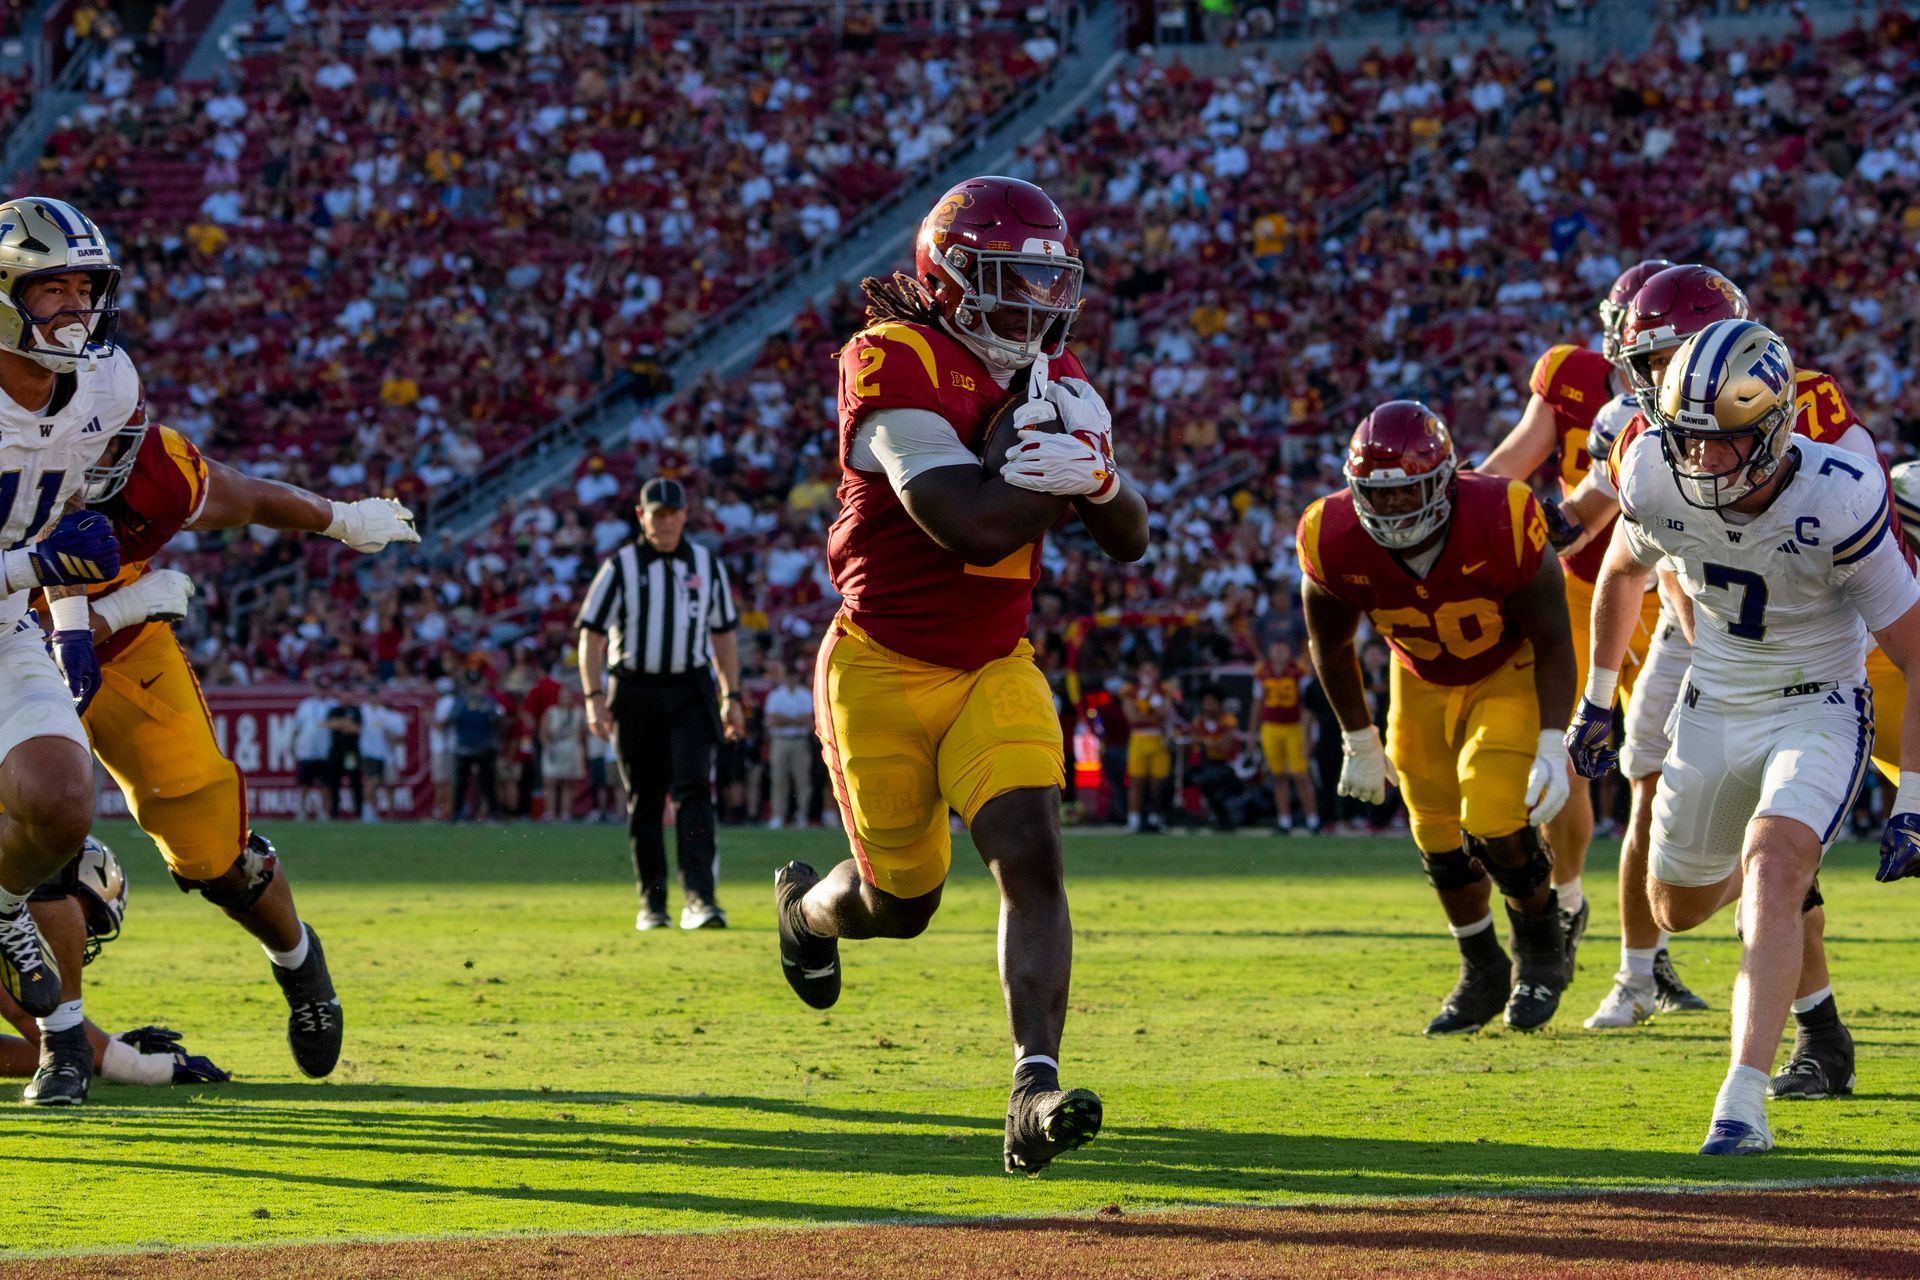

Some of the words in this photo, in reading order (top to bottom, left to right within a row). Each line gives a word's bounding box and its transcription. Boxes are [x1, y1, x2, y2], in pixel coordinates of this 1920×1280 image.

[77, 248, 104, 258] DAWGS
[855, 346, 887, 397] 2
[1746, 340, 1790, 397] W
[39, 424, 54, 437] W
[1681, 414, 1709, 426] DAWGS
[1795, 381, 1847, 440] 73
[1819, 457, 1864, 482] 7
[0, 468, 66, 550] 11
[1725, 530, 1743, 543] W
[1795, 516, 1821, 546] C
[1703, 561, 1769, 641] 7
[234, 713, 262, 773] &
